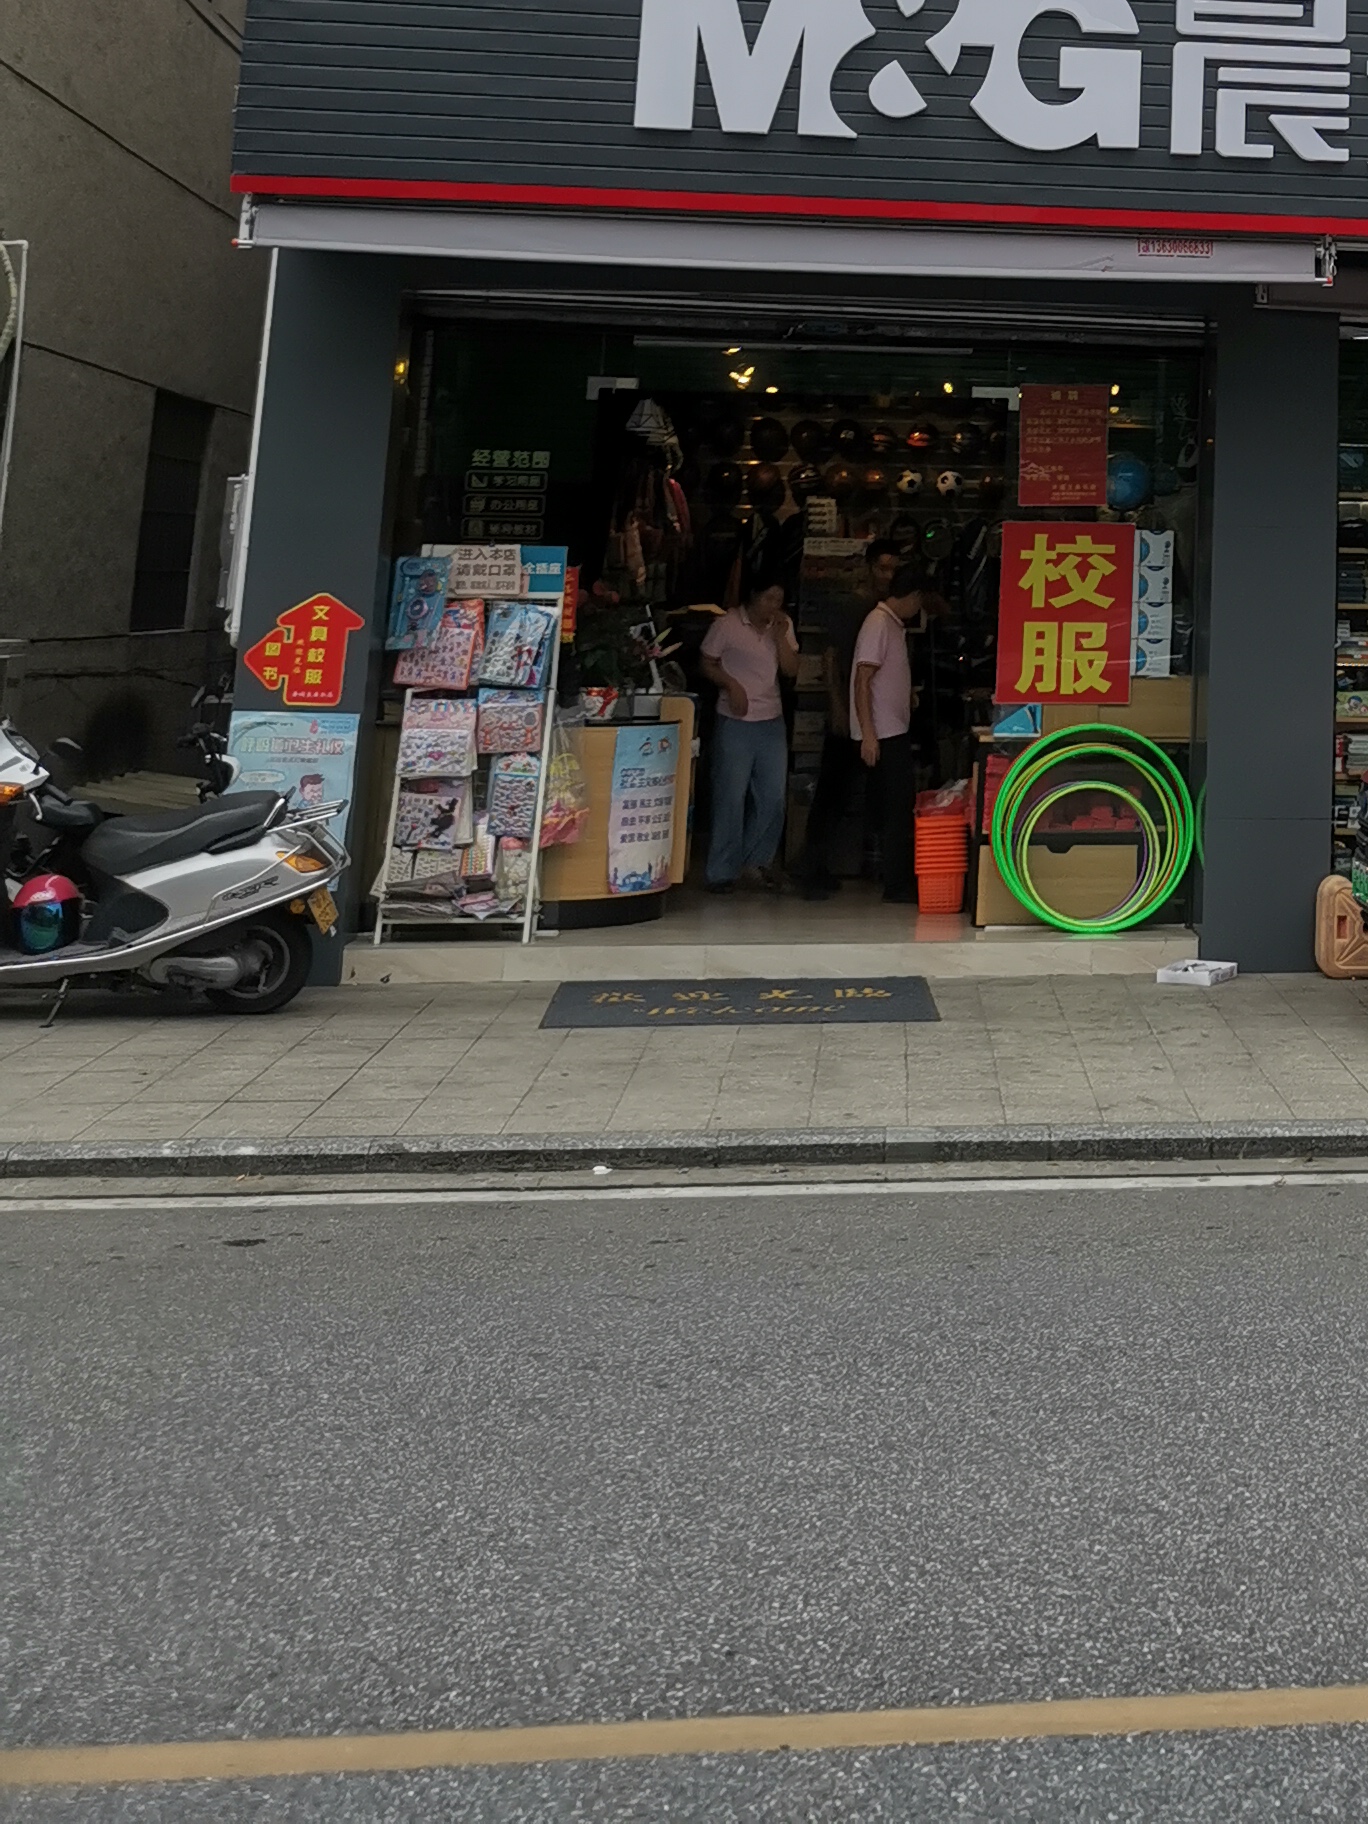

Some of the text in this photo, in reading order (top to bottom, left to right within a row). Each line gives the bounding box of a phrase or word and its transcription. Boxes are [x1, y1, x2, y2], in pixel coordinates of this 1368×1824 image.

[471, 448, 550, 469] 经营范围
[457, 547, 517, 561] 进入本店
[456, 563, 517, 576] 请戴口罩
[1015, 533, 1118, 696] 校服
[304, 605, 331, 684] 文具校服
